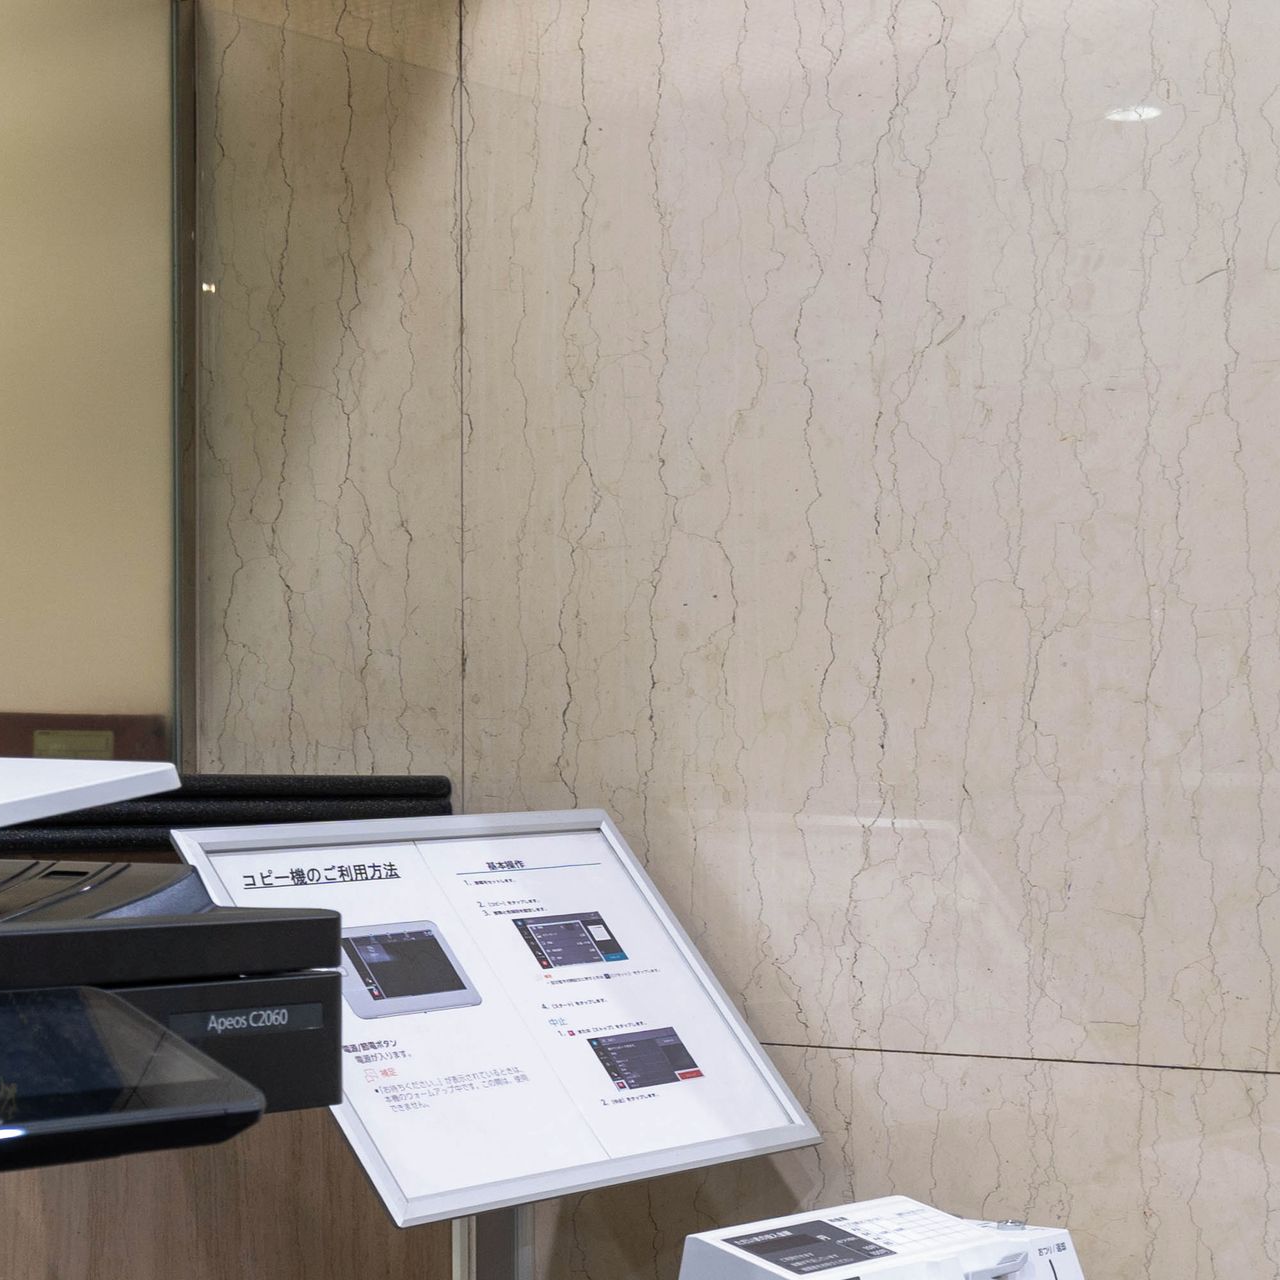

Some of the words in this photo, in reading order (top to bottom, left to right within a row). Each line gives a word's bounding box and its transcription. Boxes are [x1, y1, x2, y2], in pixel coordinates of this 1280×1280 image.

[242, 862, 401, 887] コピー機のご利用方法
[208, 1015, 247, 1034] Apeos
[249, 1009, 288, 1027] C2060
[548, 1017, 568, 1026] 中止
[355, 1050, 412, 1064] 電源が入ります。
